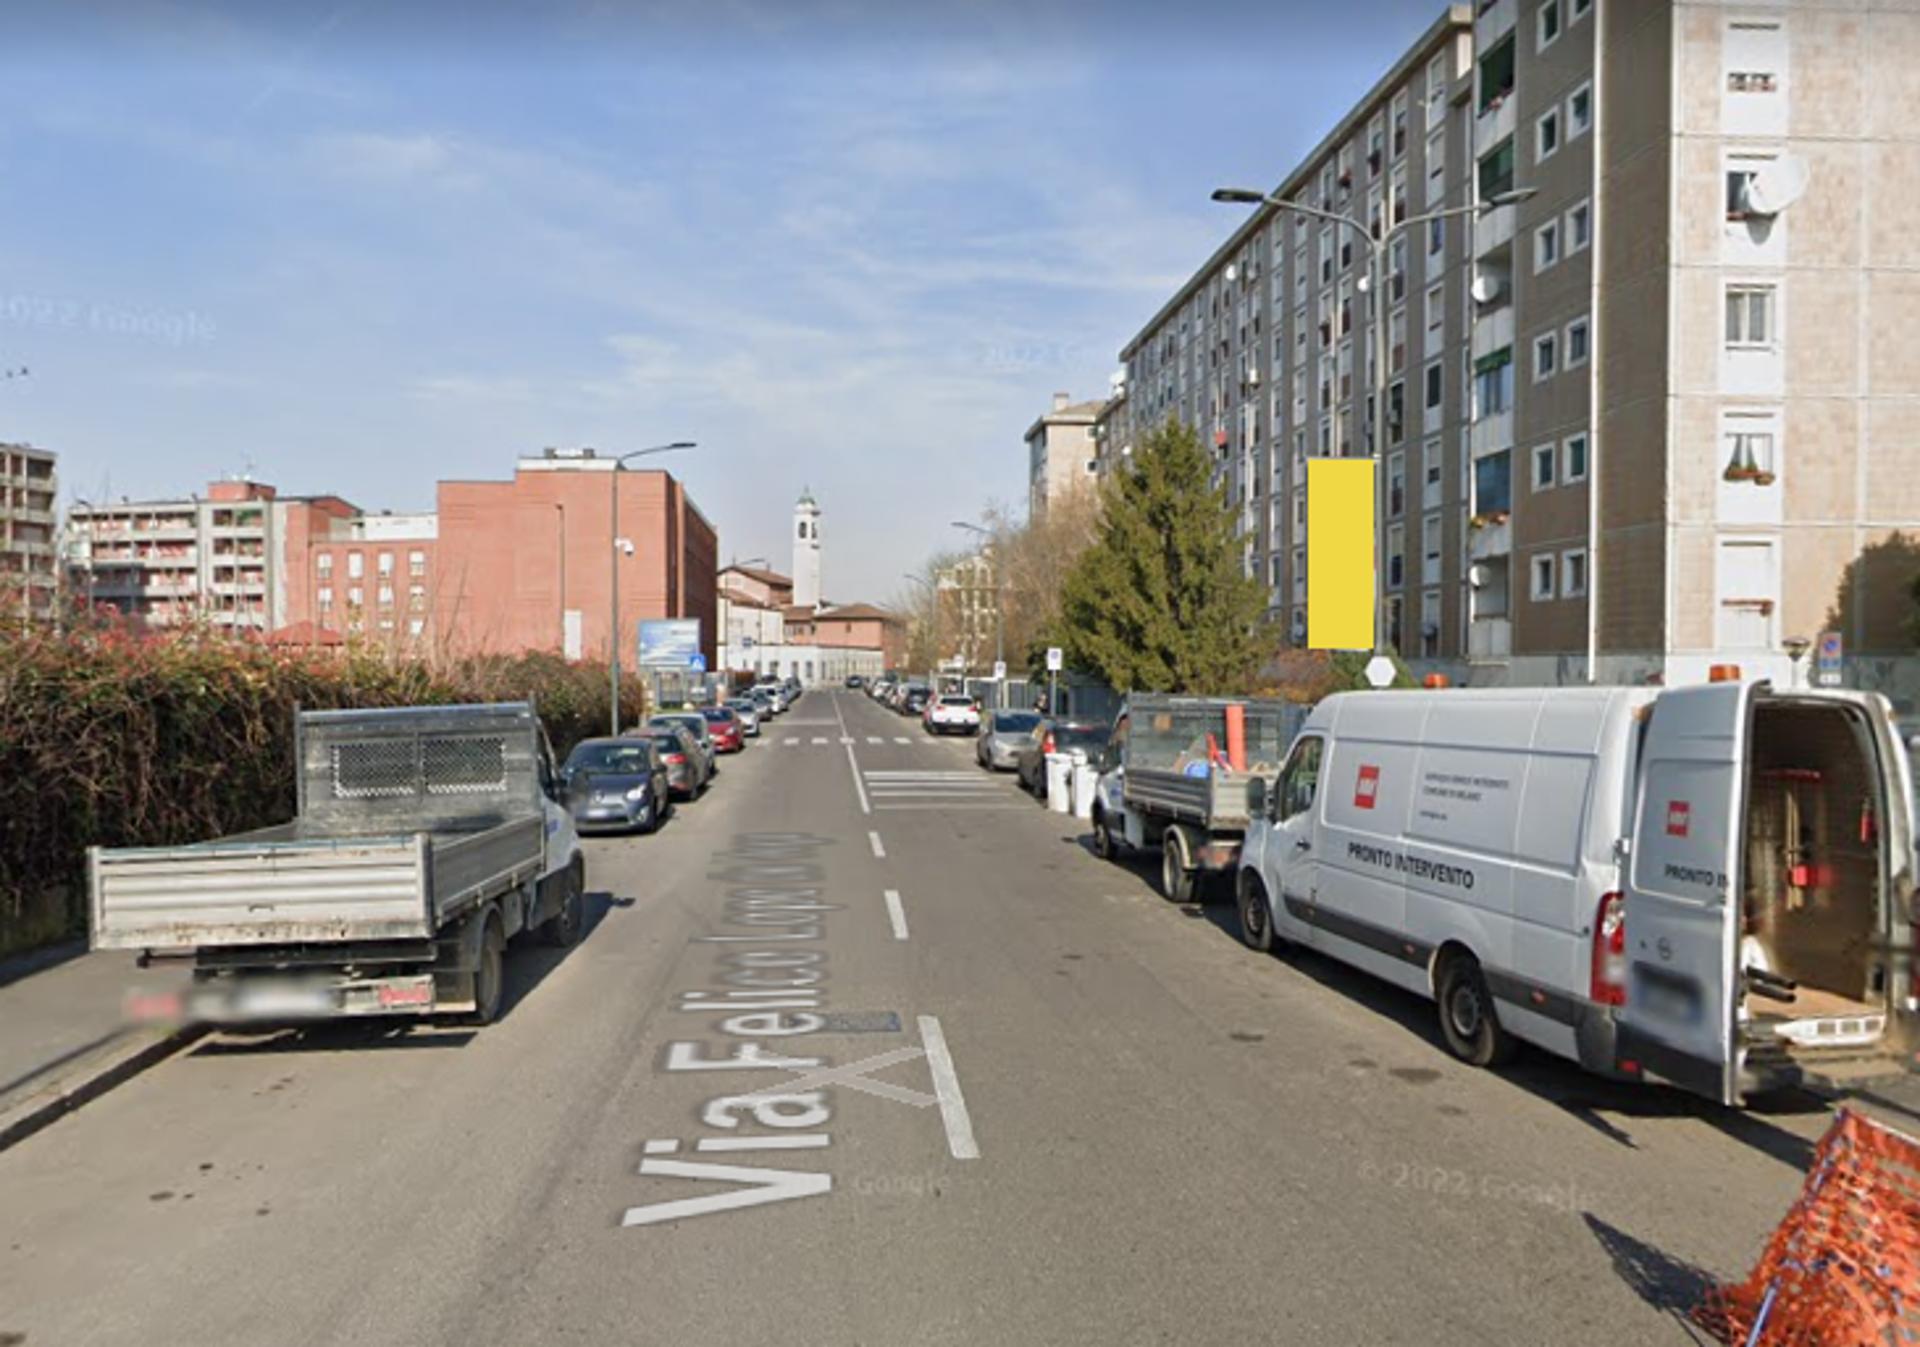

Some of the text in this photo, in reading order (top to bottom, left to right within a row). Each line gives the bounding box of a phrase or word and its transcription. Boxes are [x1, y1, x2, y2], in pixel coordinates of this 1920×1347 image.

[1348, 842, 1474, 889] PRONTO INTERVENTO
[1664, 863, 1714, 884] PRONTO
